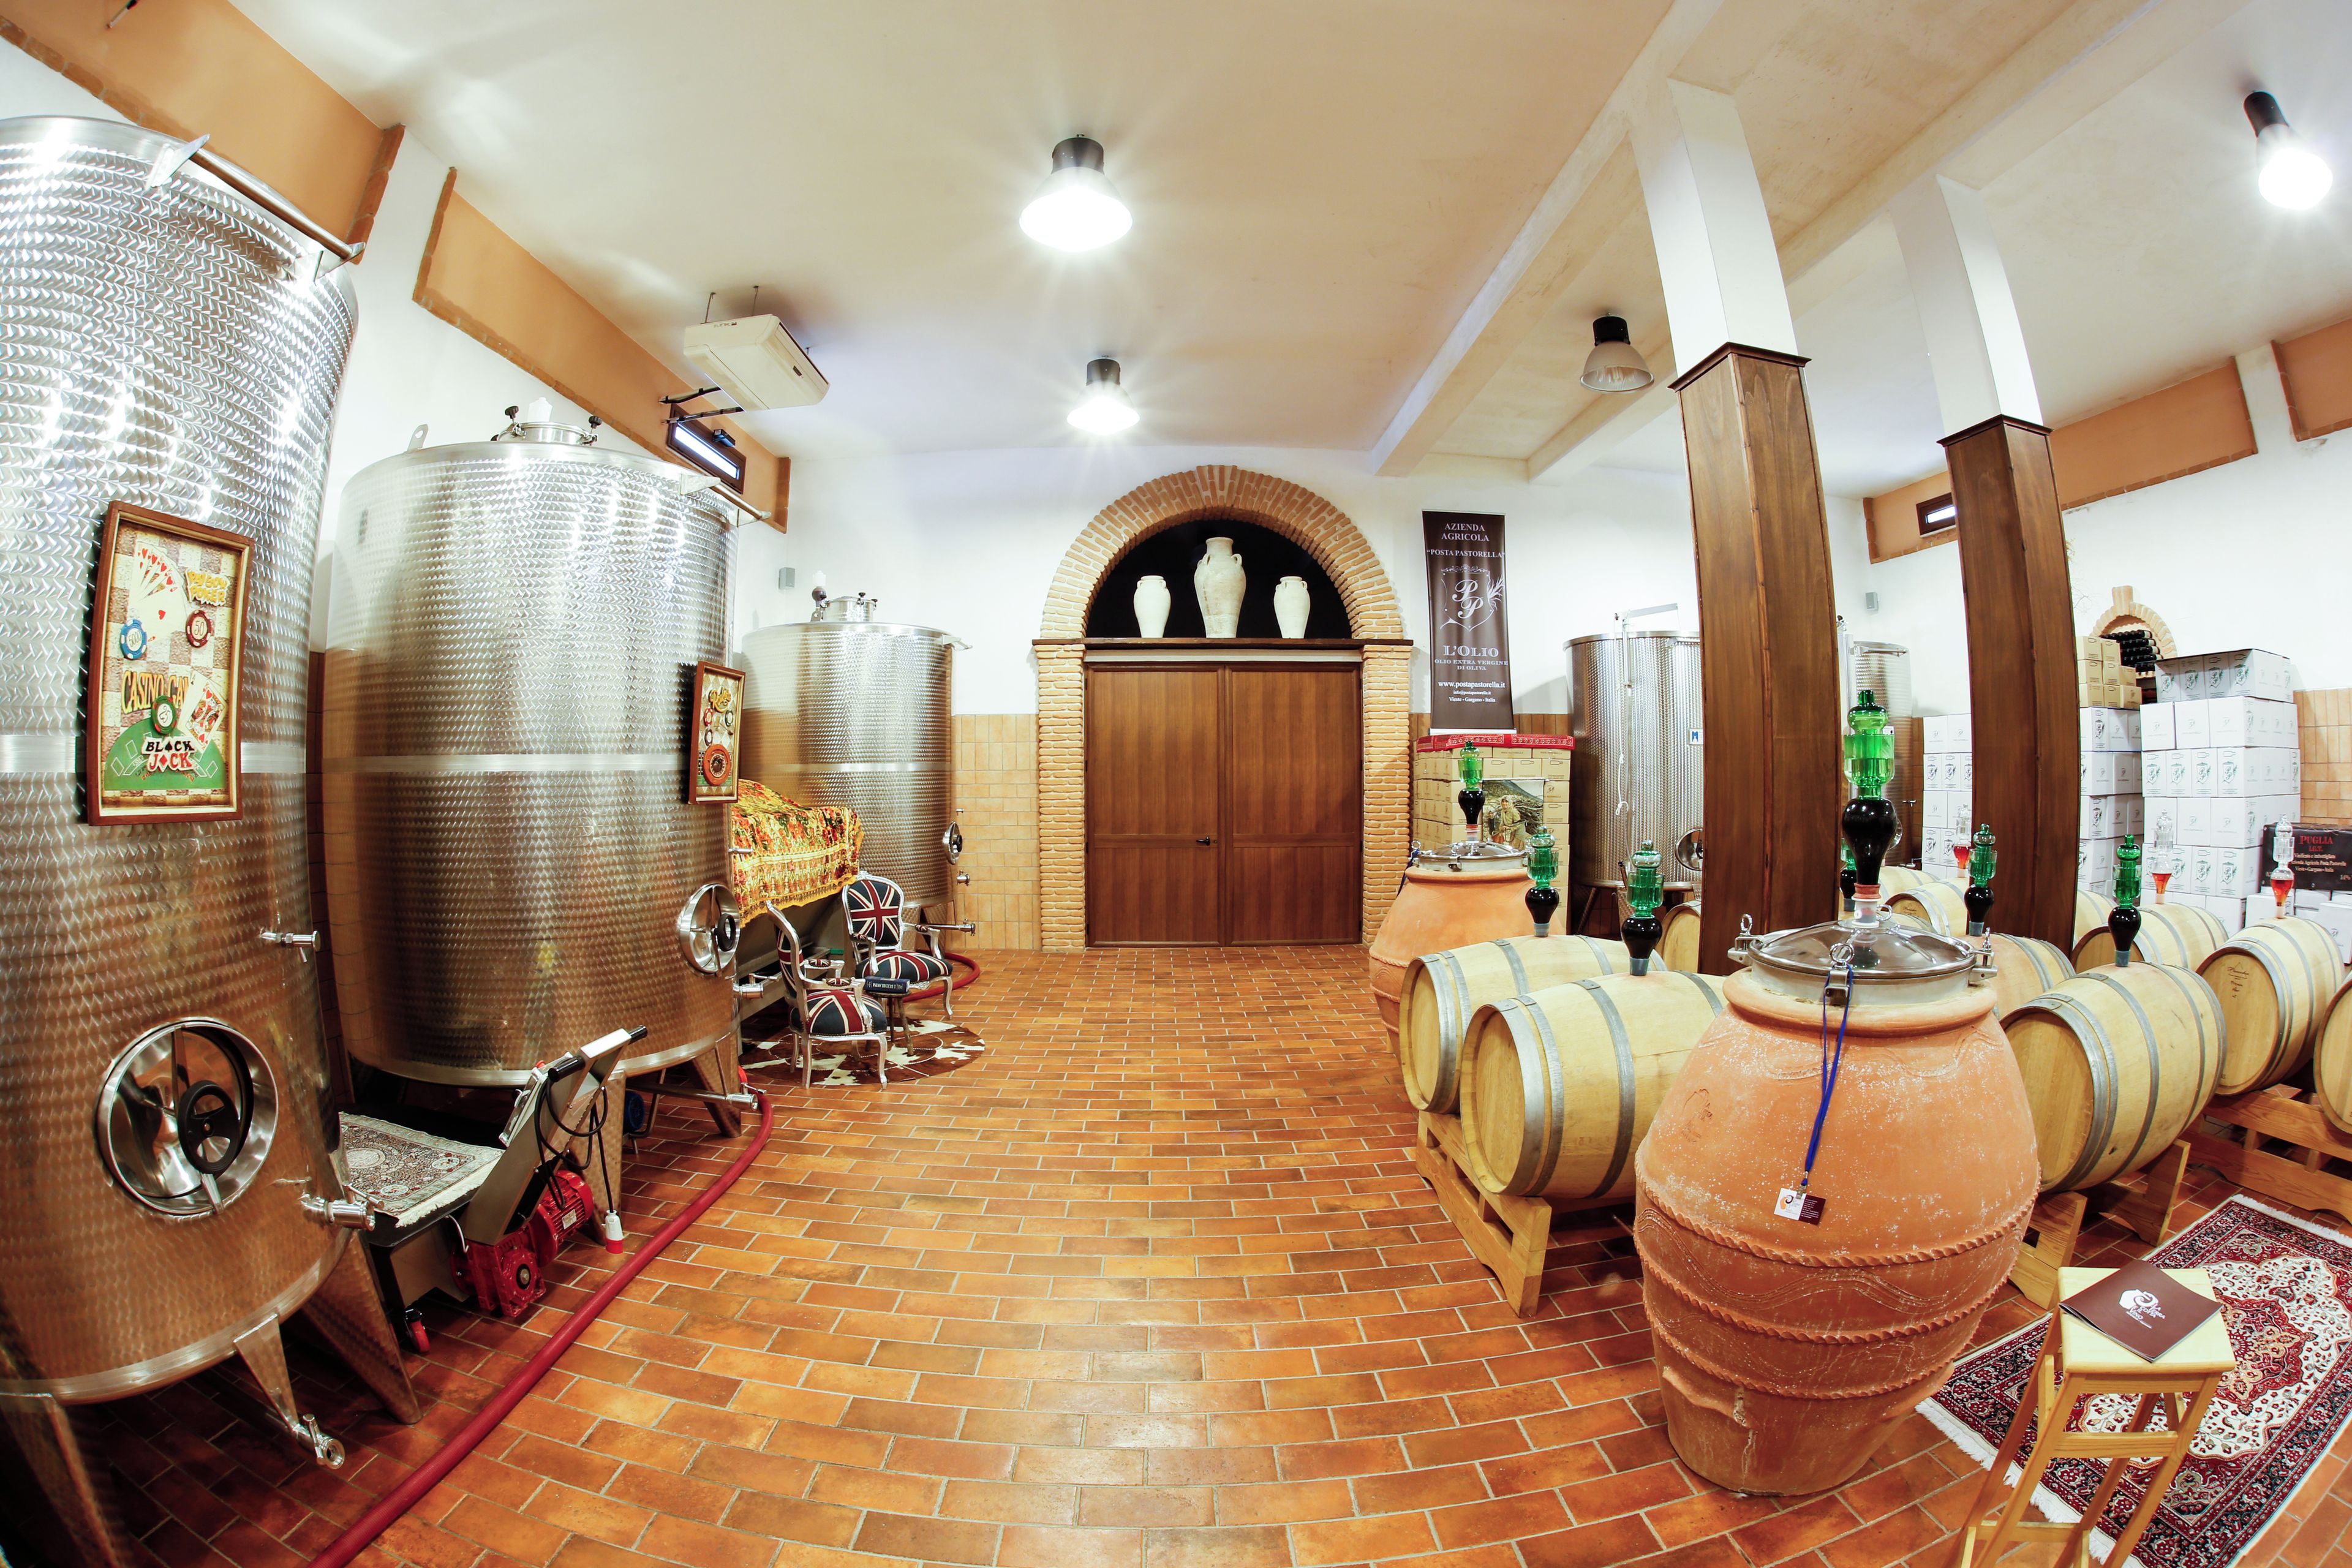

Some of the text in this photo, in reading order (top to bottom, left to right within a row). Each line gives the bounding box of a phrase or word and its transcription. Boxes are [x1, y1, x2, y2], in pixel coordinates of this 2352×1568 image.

[1445, 523, 1485, 532] AZIENDA
[1441, 533, 1490, 541] AGRICOLA
[190, 585, 225, 603] POKER
[194, 620, 205, 636] 50
[2130, 1310, 2144, 1319] VINO
